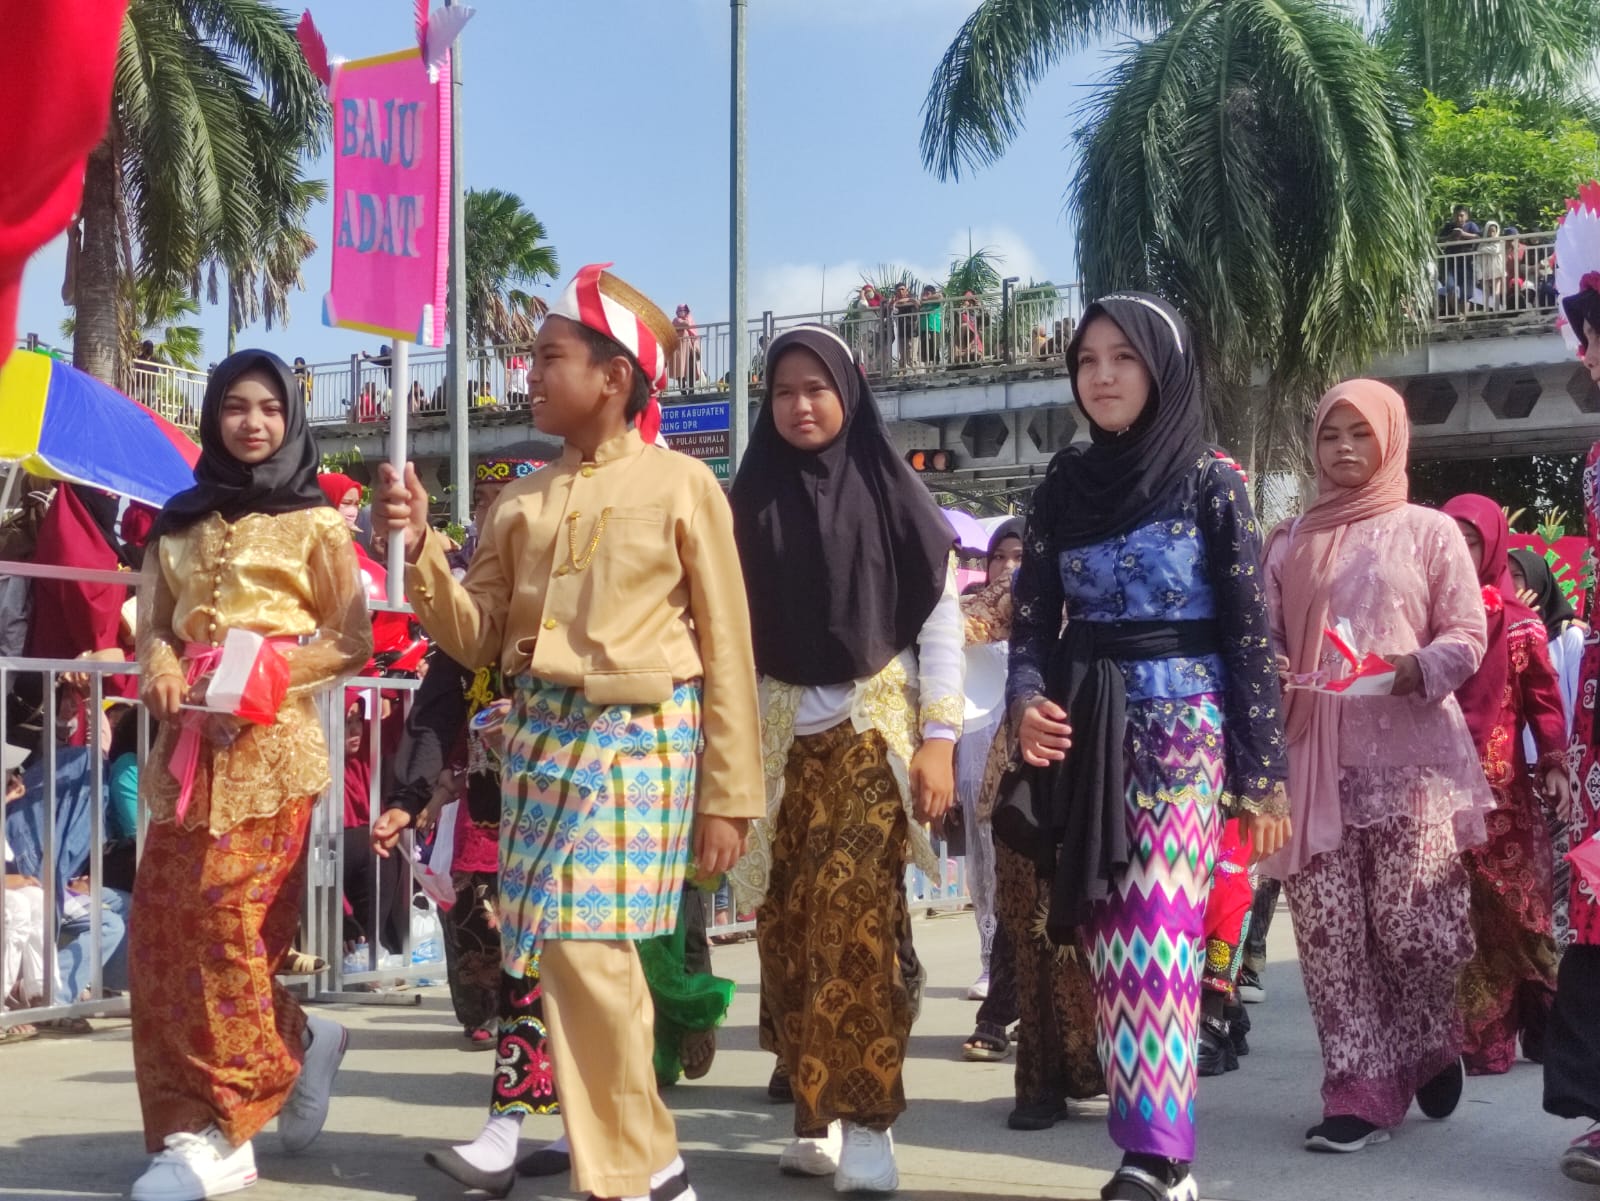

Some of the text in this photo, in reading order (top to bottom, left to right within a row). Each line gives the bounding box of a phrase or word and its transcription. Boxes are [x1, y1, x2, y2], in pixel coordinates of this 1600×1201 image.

[341, 98, 425, 169] BAJU
[338, 190, 424, 258] ADAT
[682, 406, 725, 418] KABUPATEN
[683, 420, 698, 429] DPR
[676, 436, 697, 446] PULAU
[699, 434, 725, 444] KUMALA
